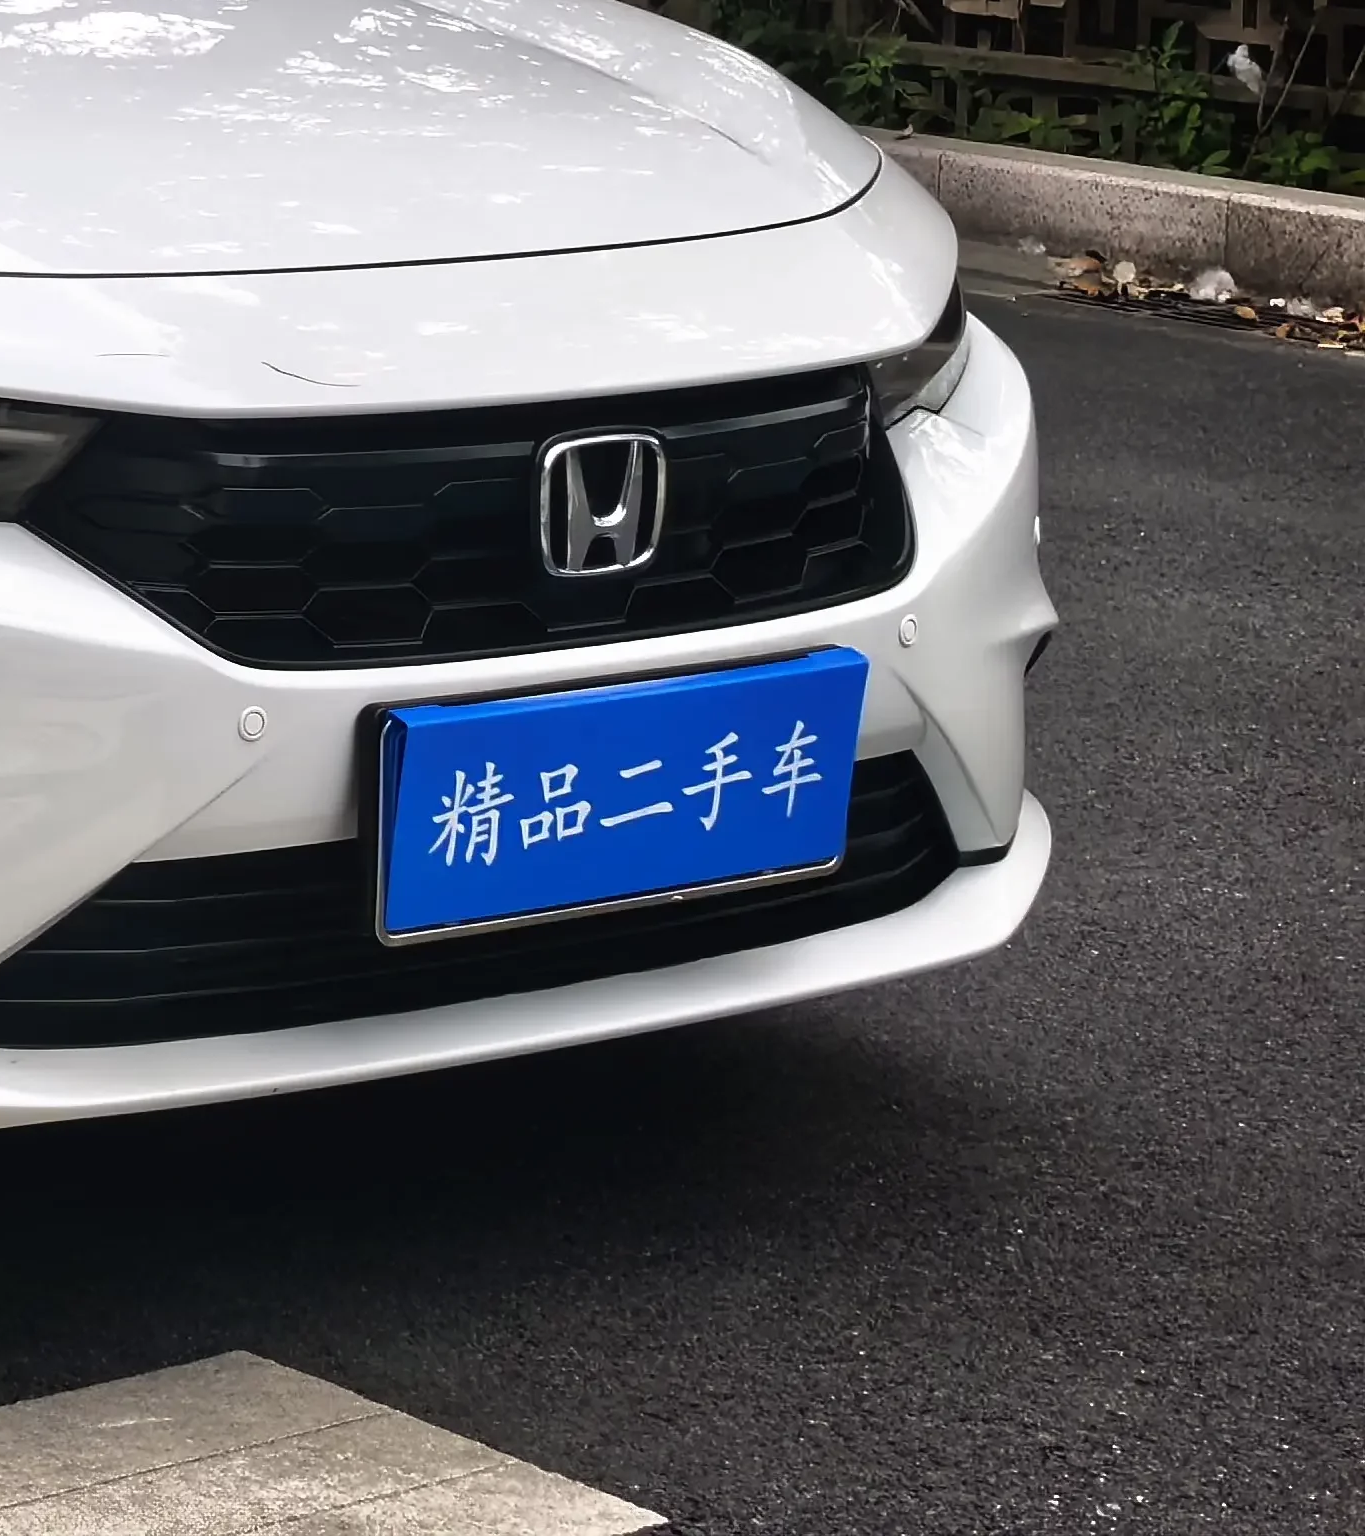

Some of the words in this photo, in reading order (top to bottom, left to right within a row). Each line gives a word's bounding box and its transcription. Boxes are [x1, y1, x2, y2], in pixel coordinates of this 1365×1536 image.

[428, 719, 823, 867] 精品二手车
